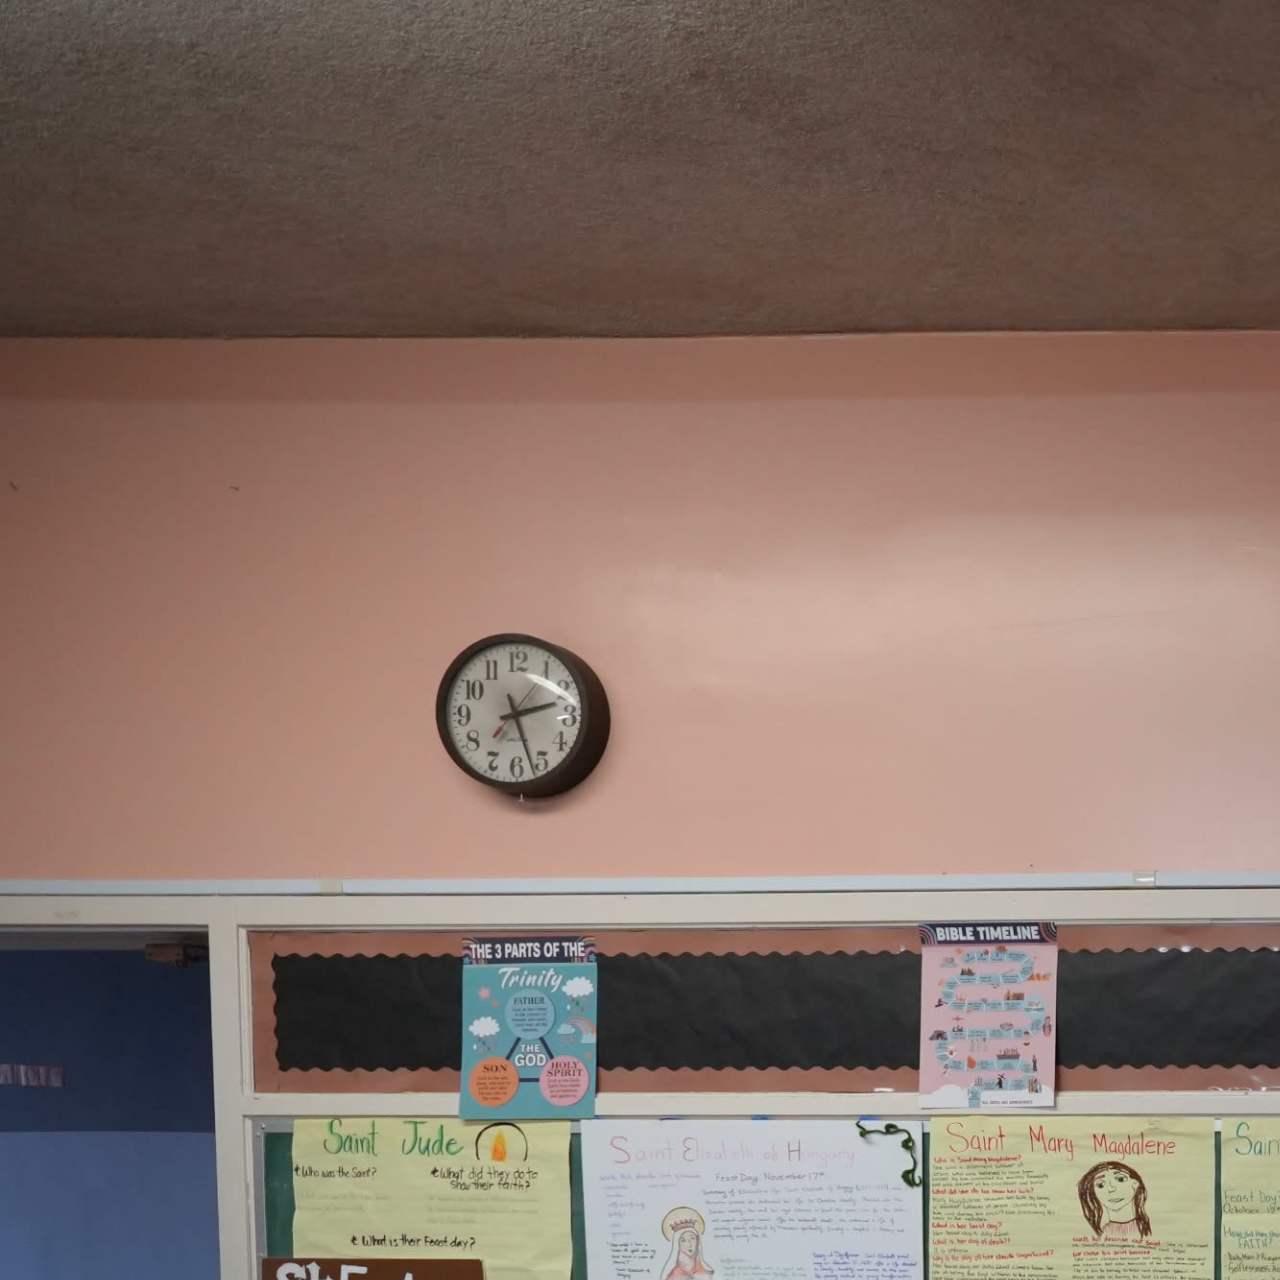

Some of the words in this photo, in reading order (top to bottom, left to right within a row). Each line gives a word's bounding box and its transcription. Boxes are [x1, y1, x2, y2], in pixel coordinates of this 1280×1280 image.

[485, 660, 498, 680] 11
[508, 651, 528, 672] 12
[543, 660, 550, 680] 1
[465, 679, 484, 700] 10
[556, 680, 570, 701] 2
[457, 704, 471, 726] 9
[561, 704, 577, 727] 3
[466, 730, 480, 751] 8
[553, 730, 567, 751] 4
[487, 751, 499, 771] 7
[510, 756, 524, 778] 6
[535, 751, 548, 771] 5
[936, 927, 974, 941] BIBLE
[977, 926, 1040, 940] TIMELINE
[470, 943, 493, 959] THE
[495, 943, 502, 959] 3
[505, 942, 541, 958] PARTS
[543, 942, 560, 958] OF
[562, 941, 585, 957] THE
[499, 967, 563, 992] Trinity
[513, 996, 545, 1006] FATHER
[521, 1044, 540, 1053] THE
[482, 1064, 507, 1073] SON
[515, 1054, 547, 1067] GOD
[551, 1061, 580, 1070] HOLY
[546, 1069, 583, 1078] SPIRIT
[323, 1119, 379, 1156] Saint
[400, 1120, 465, 1156] Jude
[946, 1122, 1007, 1153] Saint
[1029, 1125, 1074, 1161] Mary
[1092, 1132, 1176, 1161] Magdalene
[610, 1135, 672, 1163] Saint
[682, 1137, 752, 1161] Elizabeth
[337, 1166, 350, 1177] the
[440, 1168, 464, 1180] What
[468, 1168, 483, 1180] did
[487, 1169, 510, 1184] they
[715, 1173, 738, 1182] Feast
[764, 1172, 806, 1182] November
[471, 1179, 494, 1190] their
[1224, 1190, 1253, 1203] Feast
[362, 1235, 386, 1248] What
[389, 1237, 398, 1248] is
[400, 1235, 421, 1248] their
[450, 1235, 476, 1249] day?
[1239, 1238, 1273, 1249] FAITH?
